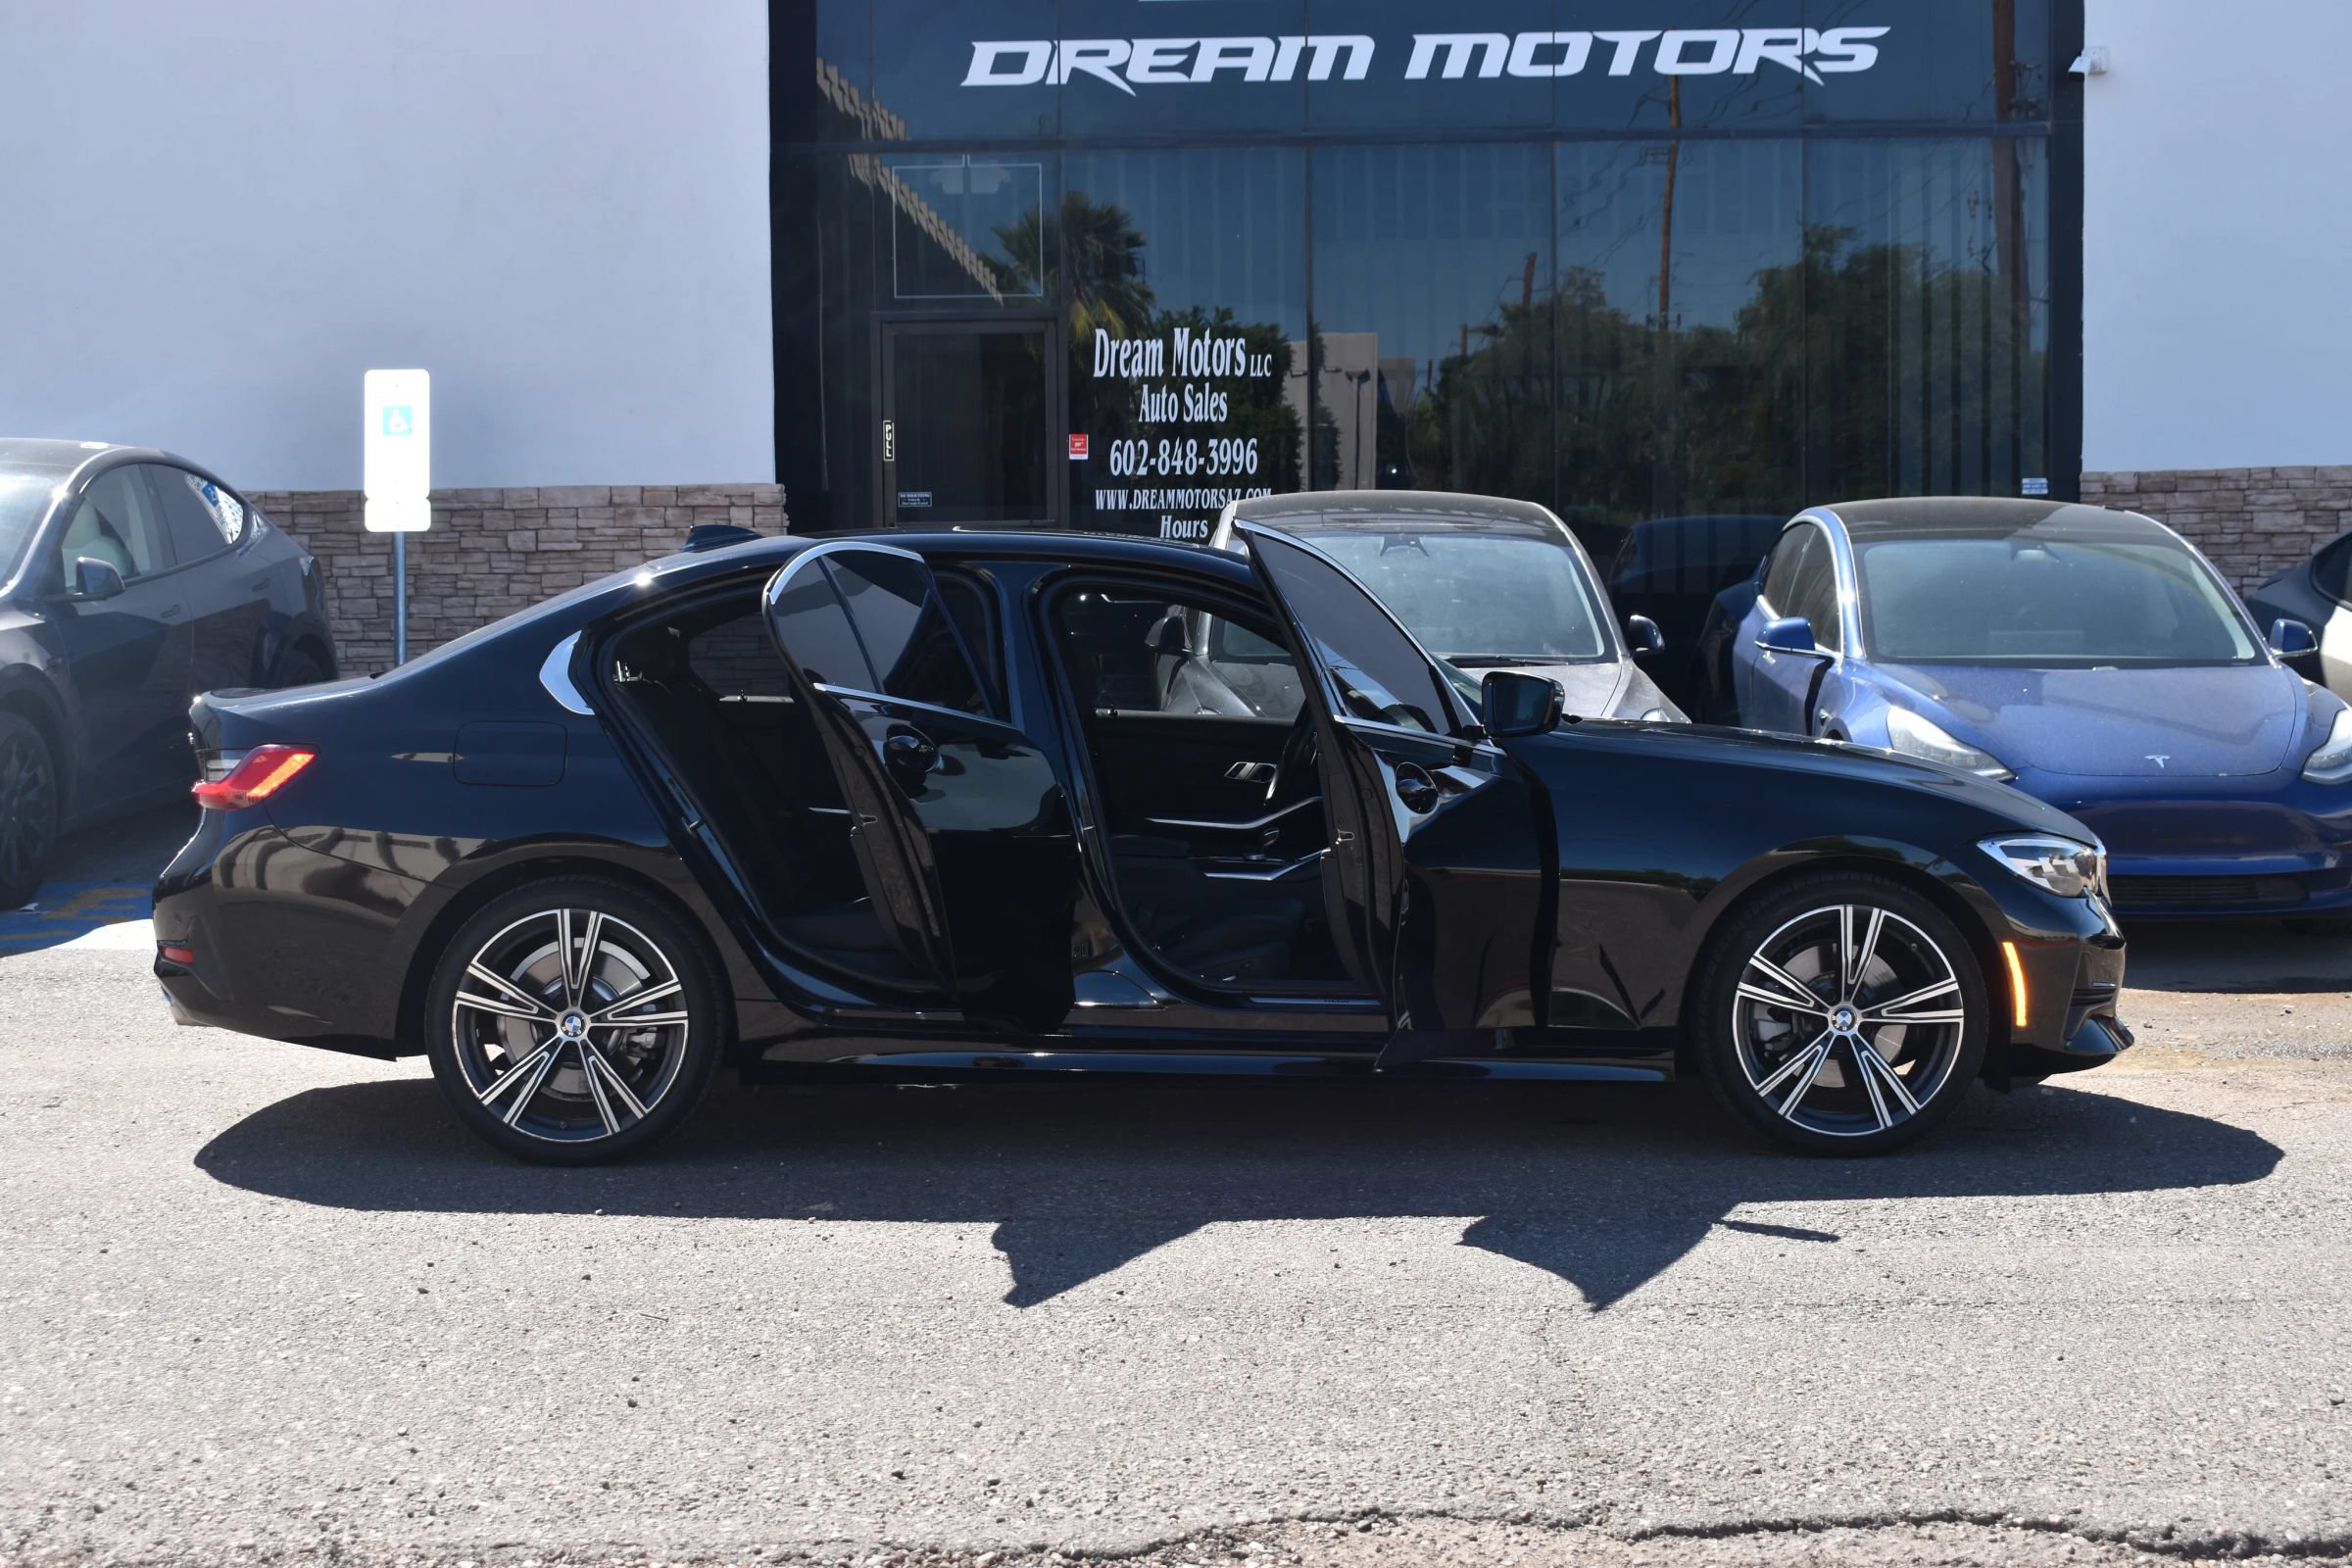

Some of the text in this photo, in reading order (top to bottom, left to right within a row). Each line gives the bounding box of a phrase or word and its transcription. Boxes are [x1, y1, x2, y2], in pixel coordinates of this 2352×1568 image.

[960, 26, 1891, 96] DREAM MOTORS
[1093, 326, 1273, 378] Dream Motors LLC
[1138, 381, 1228, 423] Auto Sales
[1109, 436, 1258, 476] 602-848-3996
[1095, 488, 1272, 511] WWW.DREAMMOTORSAZC
[1159, 514, 1208, 539] Hours
